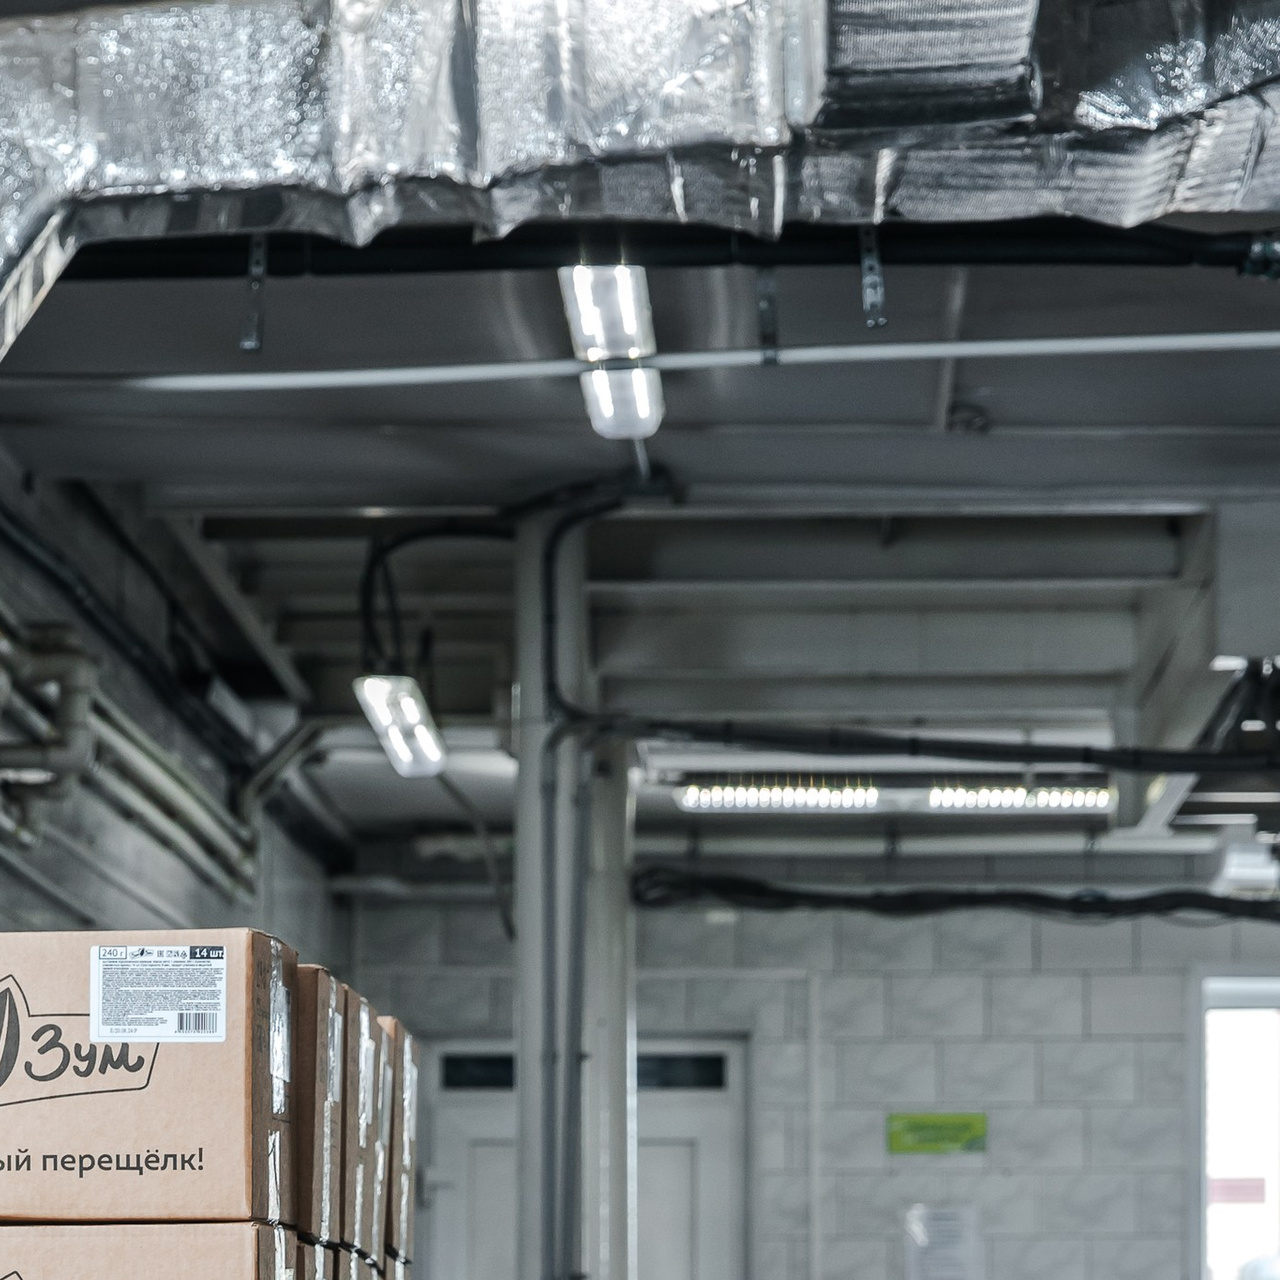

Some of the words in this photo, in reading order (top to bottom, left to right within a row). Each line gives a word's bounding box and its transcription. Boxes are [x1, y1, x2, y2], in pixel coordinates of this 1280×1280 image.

[102, 948, 118, 957] 240
[195, 948, 207, 958] 14
[23, 1023, 145, 1082] Зум
[42, 1147, 204, 1179] перещёлк!
